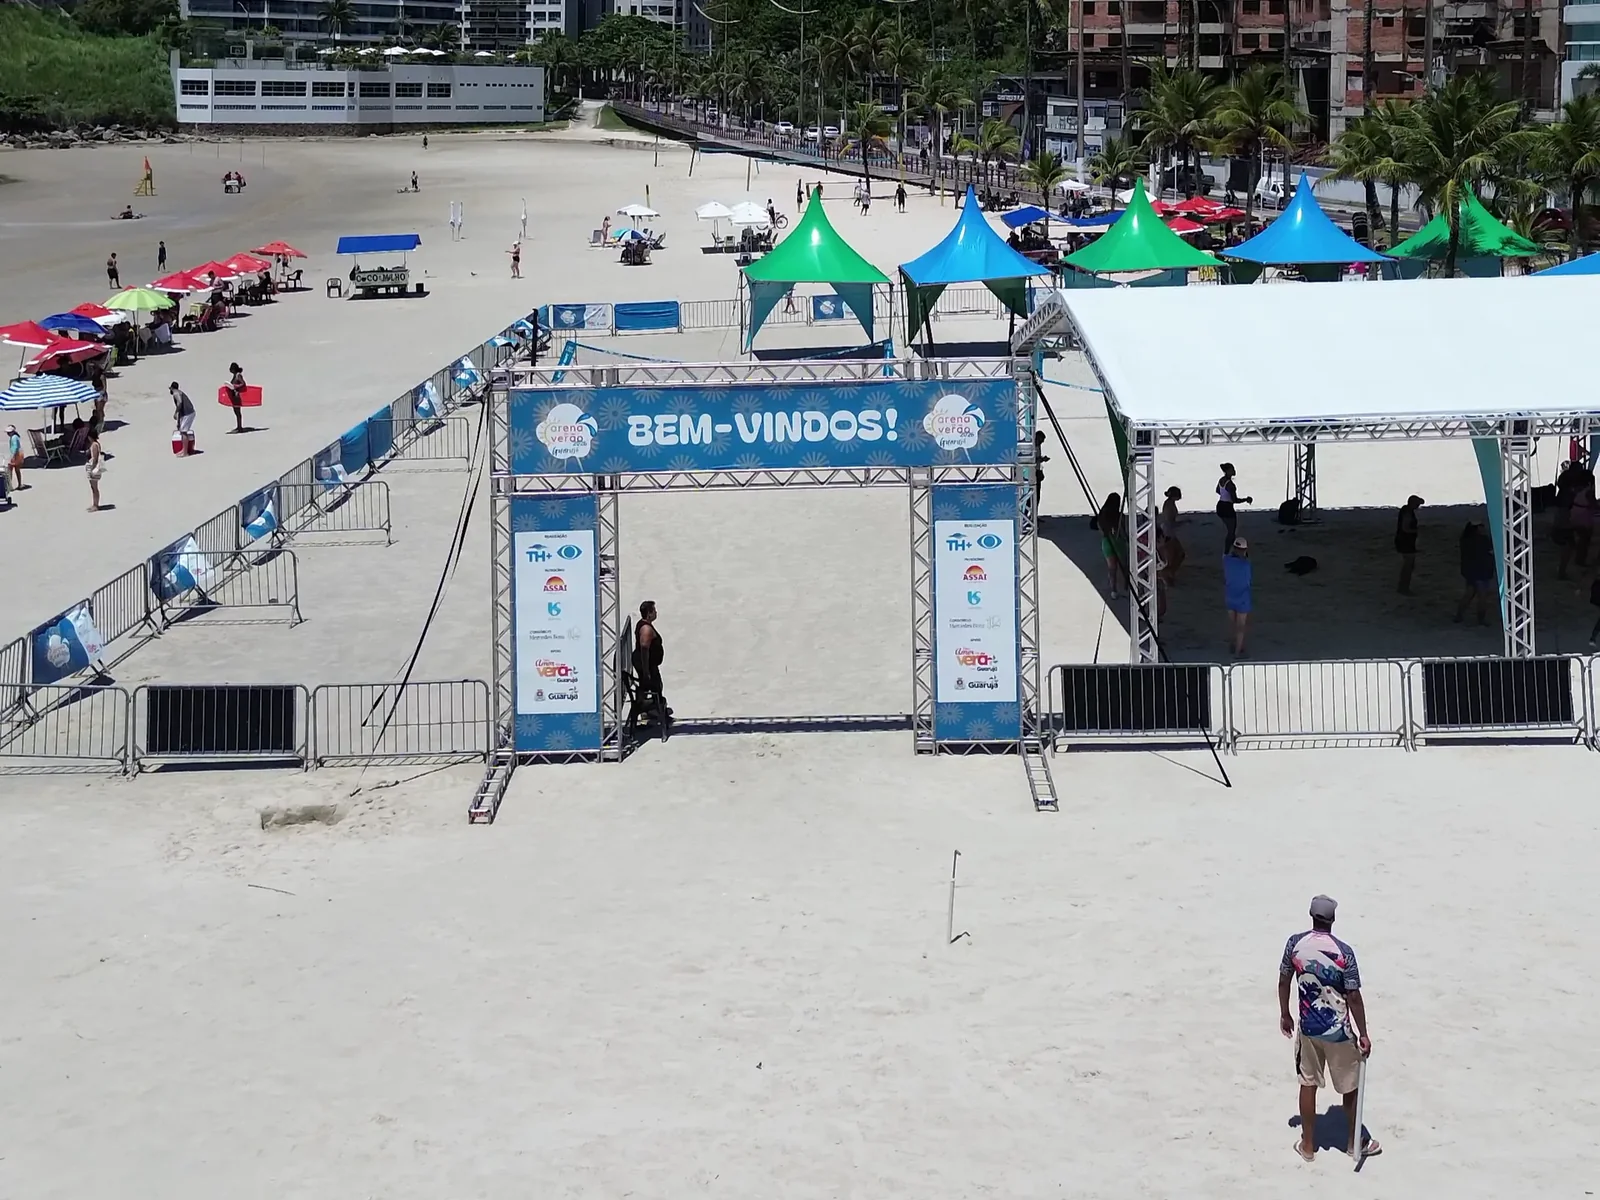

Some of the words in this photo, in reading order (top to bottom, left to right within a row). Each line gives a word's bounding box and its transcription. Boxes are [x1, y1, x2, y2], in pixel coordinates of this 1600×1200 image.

[627, 408, 899, 446] BEM-VINDOS!
[946, 540, 972, 551] TH+
[526, 551, 552, 562] TH+
[968, 681, 998, 690] Guarujá
[548, 692, 578, 701] Guarujá
